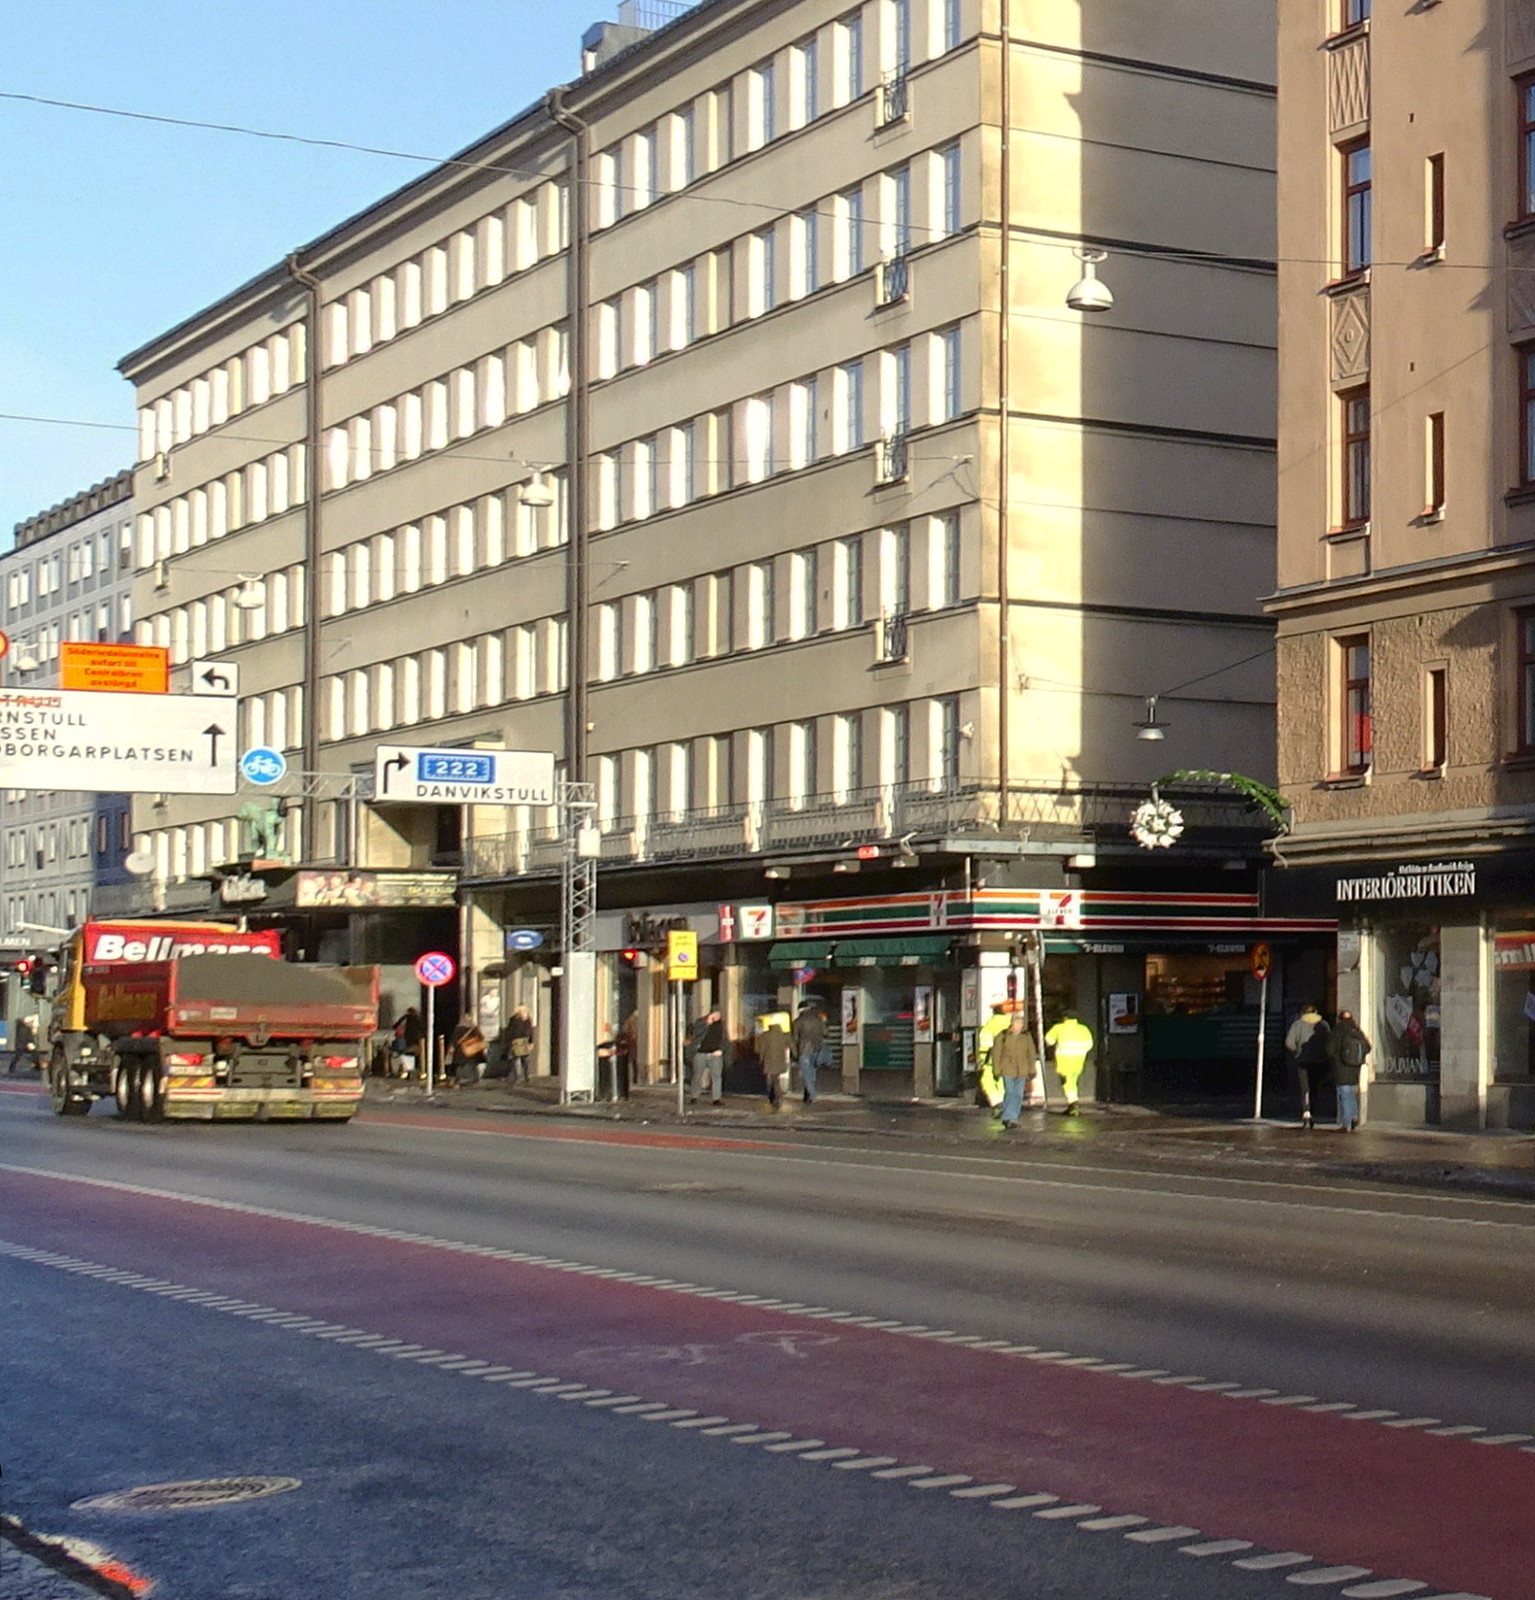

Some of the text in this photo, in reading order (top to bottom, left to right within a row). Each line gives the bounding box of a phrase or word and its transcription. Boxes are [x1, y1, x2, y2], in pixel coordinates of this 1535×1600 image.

[436, 761, 478, 776] 222
[417, 784, 548, 801] DANVIKSTULL
[1336, 871, 1476, 901] INTERIÖRBUTIKEN
